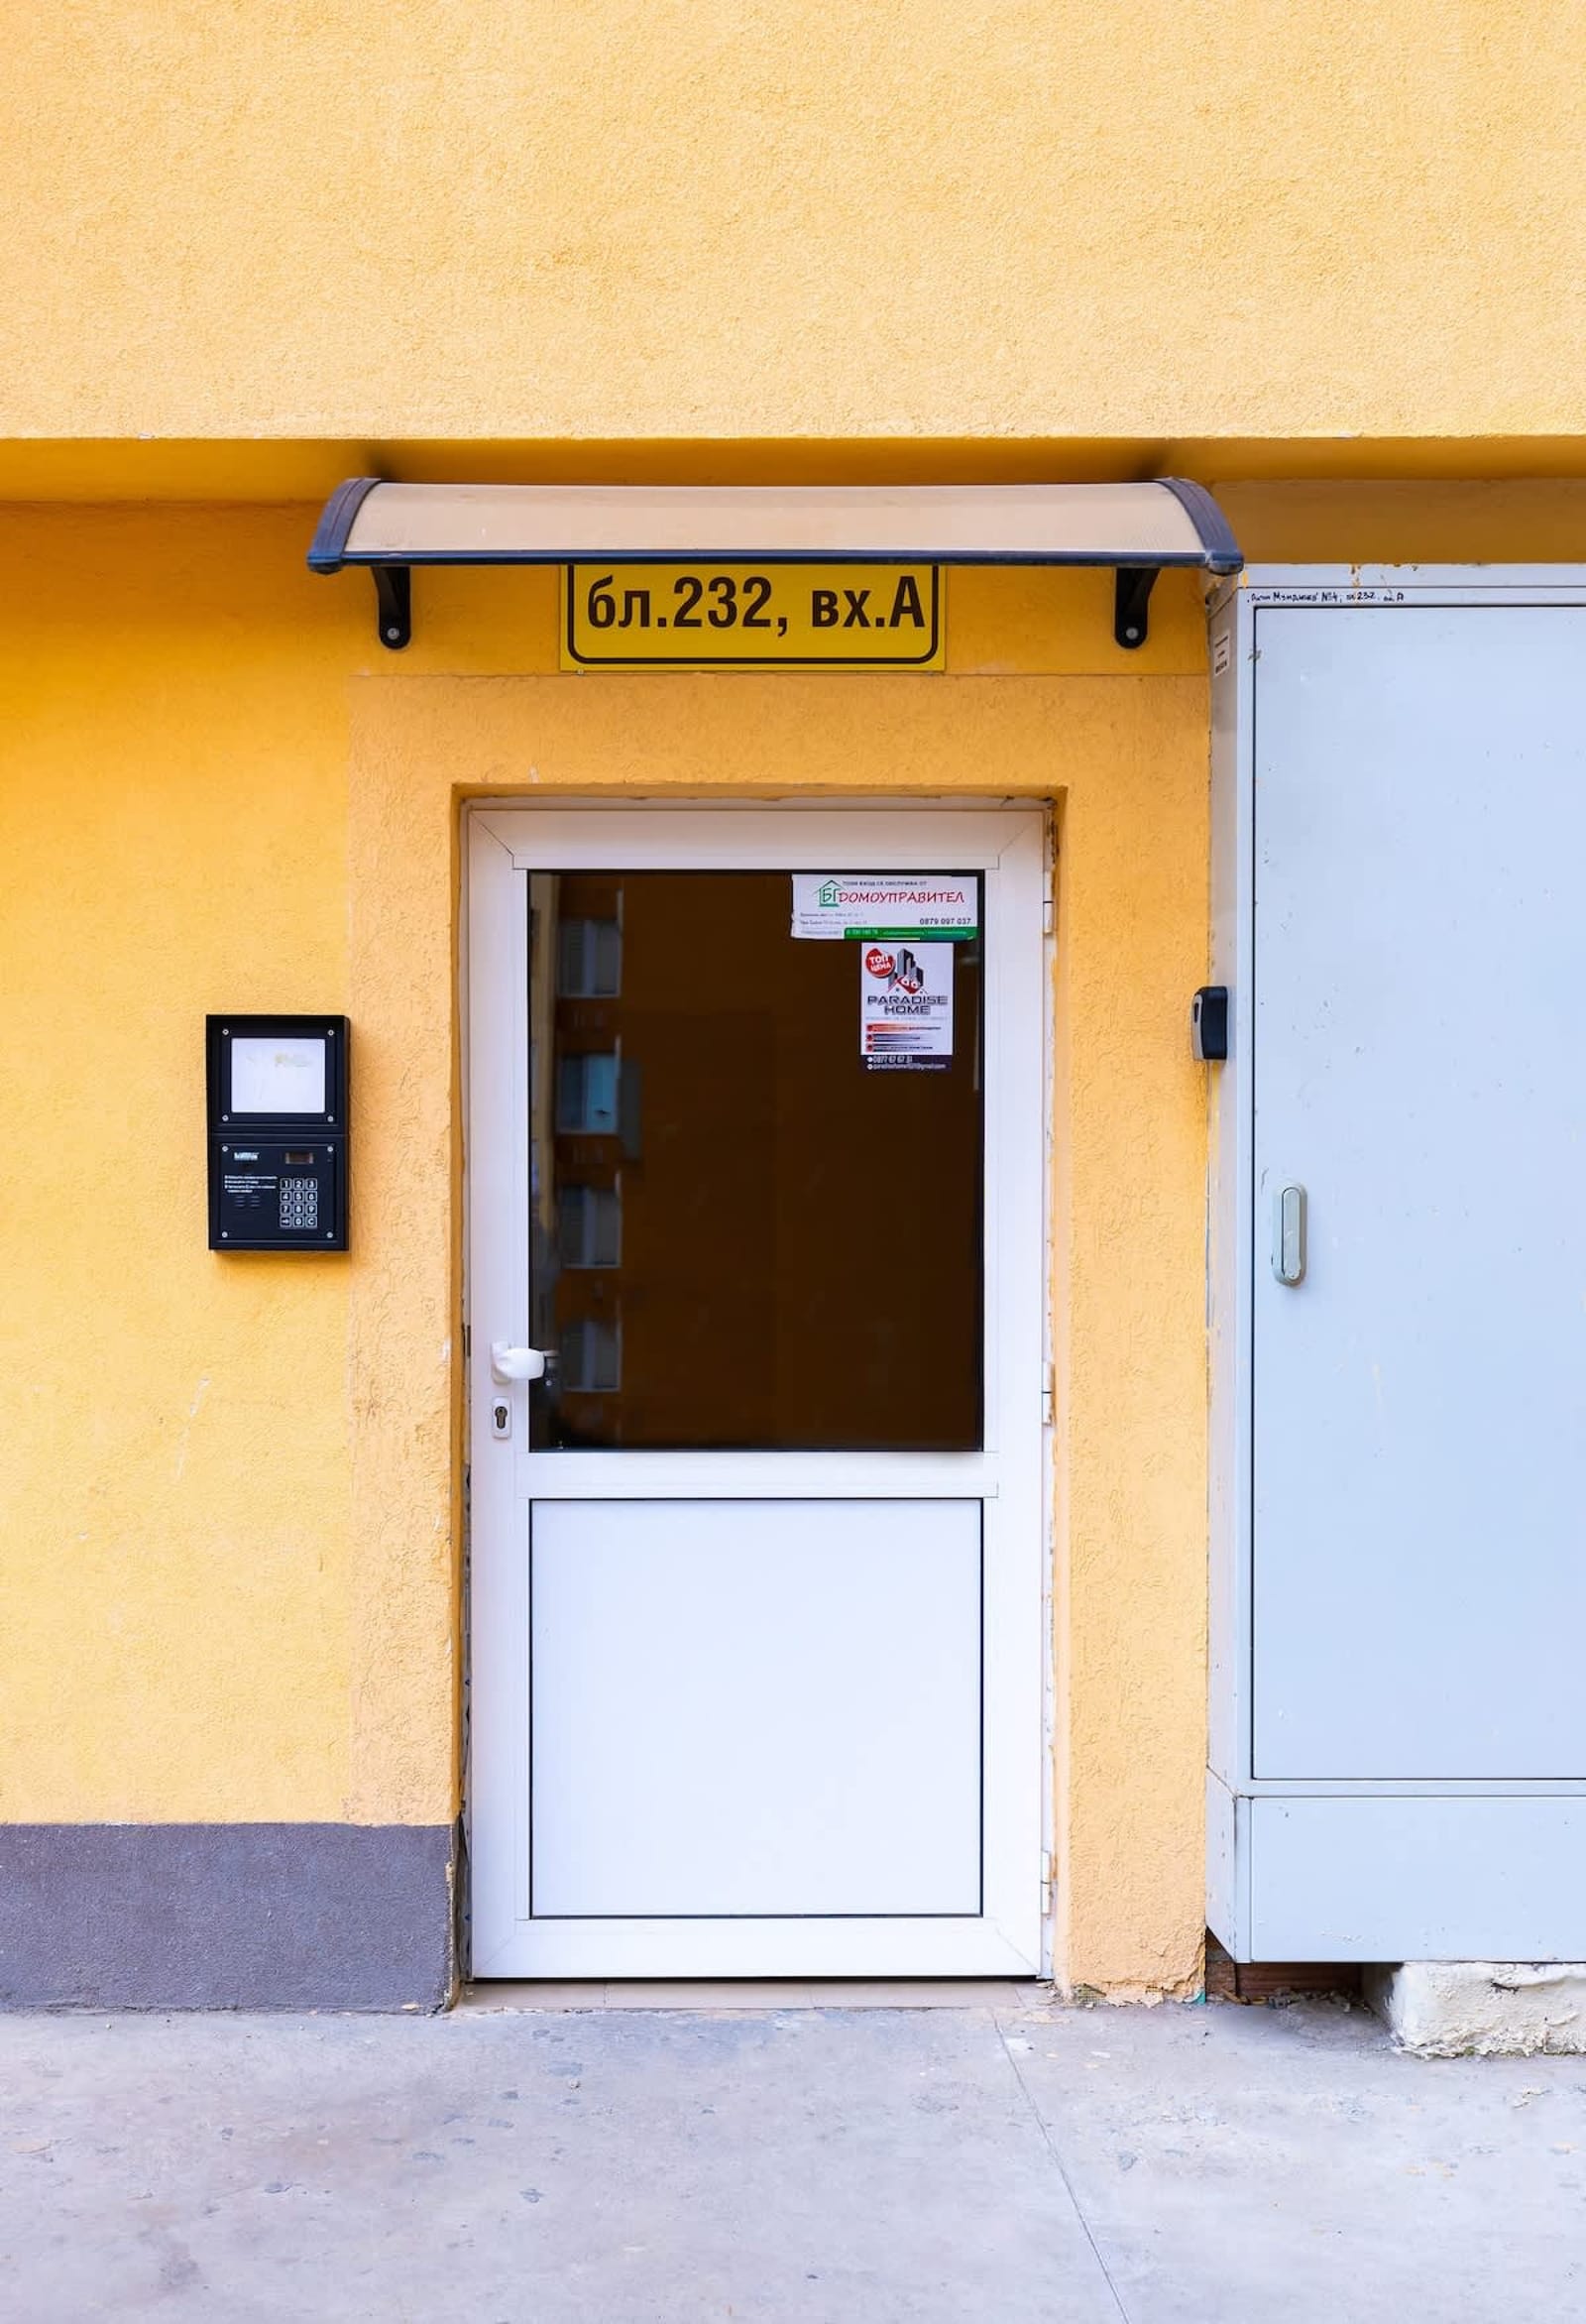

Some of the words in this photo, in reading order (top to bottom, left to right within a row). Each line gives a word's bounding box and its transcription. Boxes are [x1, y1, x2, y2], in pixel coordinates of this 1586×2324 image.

[588, 574, 788, 638] бл.232,
[812, 575, 926, 629] вх.А
[868, 955, 888, 965] ТОП
[867, 995, 948, 1005] PARADISE
[884, 1005, 931, 1015] HOME
